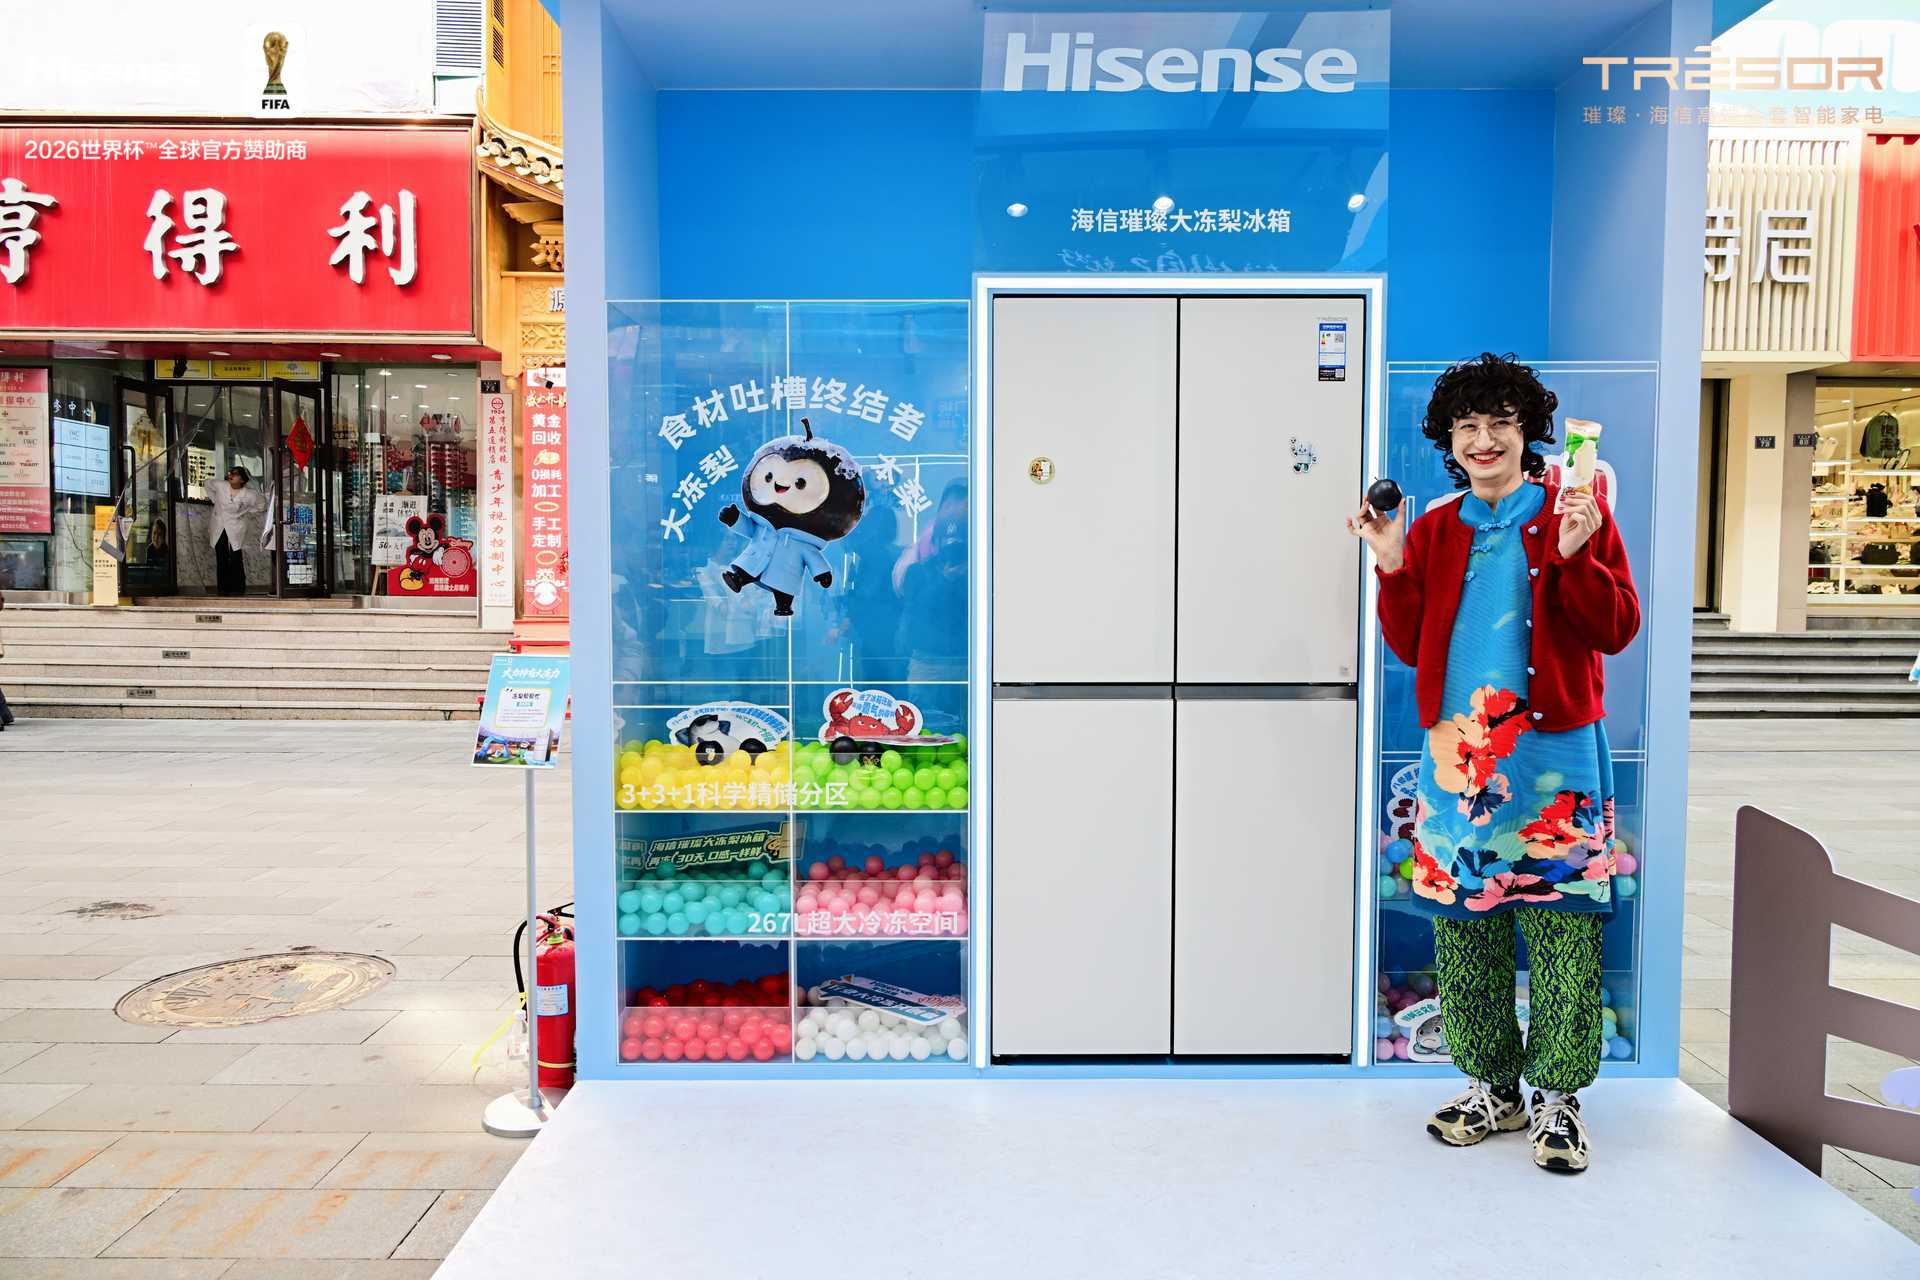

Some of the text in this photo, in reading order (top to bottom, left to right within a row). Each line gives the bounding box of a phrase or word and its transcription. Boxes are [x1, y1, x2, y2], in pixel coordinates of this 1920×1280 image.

[1003, 32, 1358, 93] Hisense
[1070, 207, 1291, 233] 海信璀璨大冻梨冰箱
[532, 413, 561, 428] 黄金
[658, 375, 926, 450] 食材吐槽终结者
[532, 430, 562, 445] 回收
[532, 483, 562, 498] 加工
[660, 444, 739, 543] 大冻梨
[532, 516, 561, 531] 手工
[532, 534, 561, 548] 定制
[622, 782, 849, 806] 3+3+1科学精储分区
[747, 911, 959, 935] 267L超大冷冻空间
